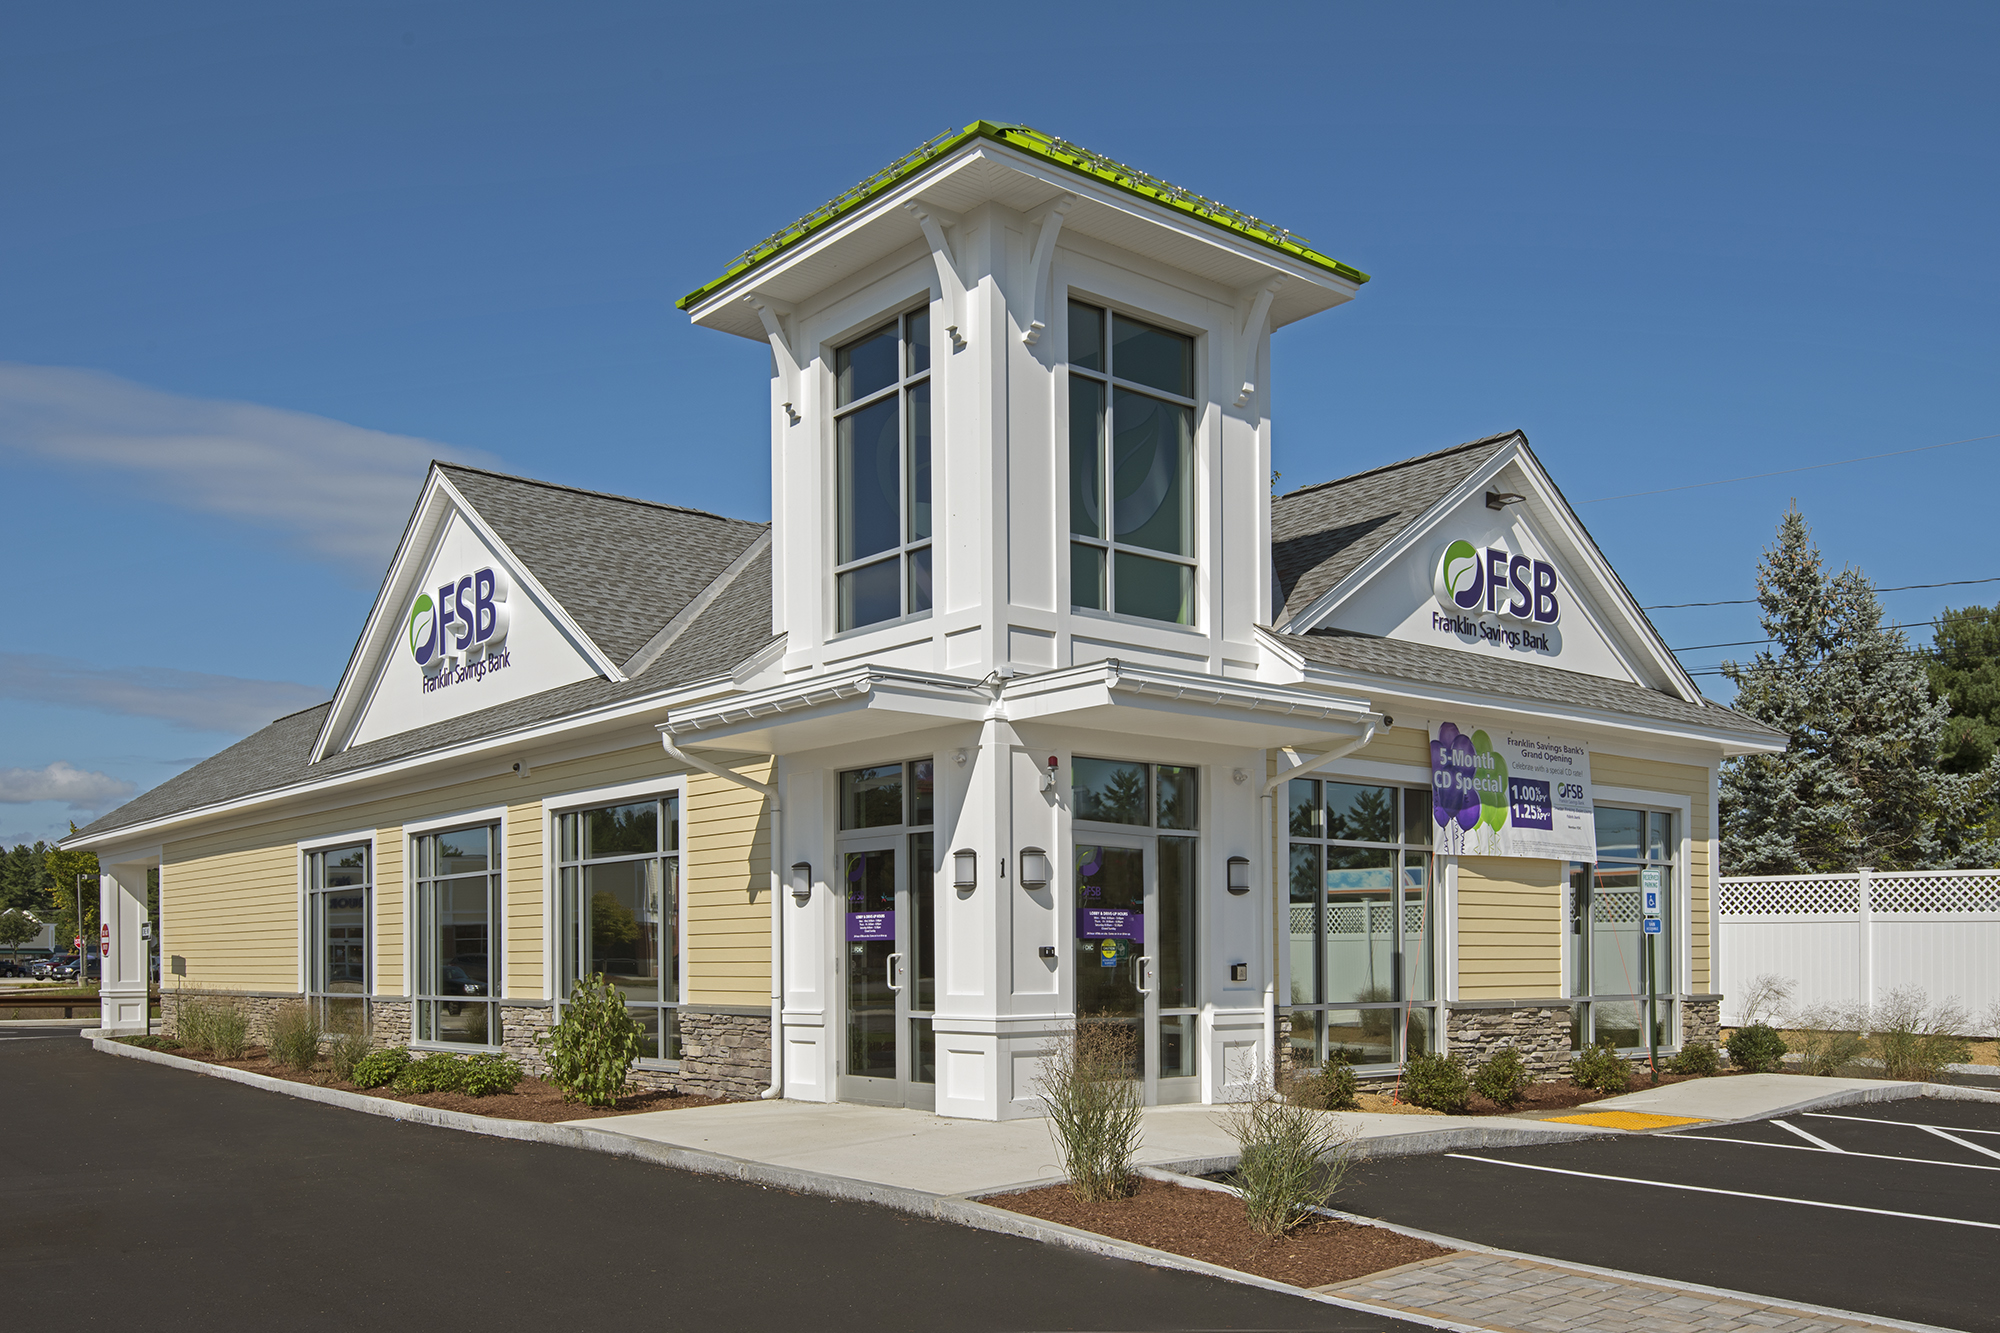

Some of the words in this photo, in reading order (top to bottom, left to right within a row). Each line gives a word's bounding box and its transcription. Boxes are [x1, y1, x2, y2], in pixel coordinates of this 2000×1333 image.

[1486, 547, 1560, 624] FSB
[438, 567, 497, 658] FSB
[1432, 611, 1477, 637] Franklin
[1480, 621, 1520, 649] Savings
[1523, 630, 1549, 651] Bank
[422, 668, 453, 694] Franklin
[455, 659, 486, 682] Savings
[488, 647, 511, 673] Bank
[1507, 737, 1535, 749] Franklin
[1536, 741, 1562, 754] Savings
[1563, 745, 1584, 755] Bank's
[1521, 749, 1543, 760] Grand
[1544, 752, 1573, 765] Opening
[1440, 747, 1495, 770] 5-Month
[1511, 761, 1534, 772] Celebrate
[1535, 765, 1545, 773] with
[1550, 767, 1564, 775] special
[1565, 768, 1573, 776] CD
[1434, 770, 1452, 788] CD
[1455, 772, 1502, 795] Special
[1566, 783, 1584, 799] FSB
